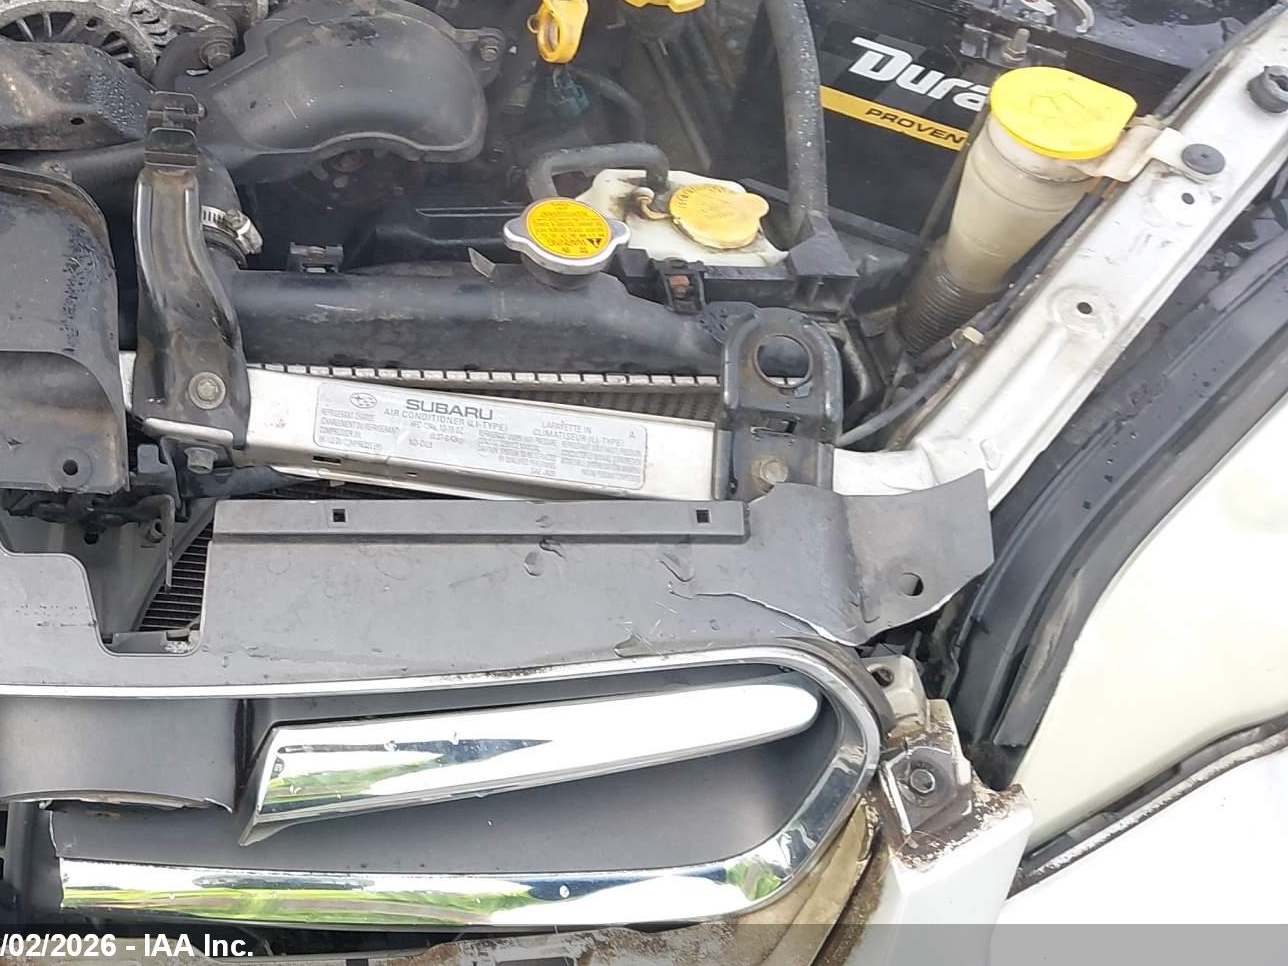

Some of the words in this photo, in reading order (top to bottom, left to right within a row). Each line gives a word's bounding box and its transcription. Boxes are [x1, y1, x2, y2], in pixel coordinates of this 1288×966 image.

[865, 107, 966, 144] PROVEN
[383, 408, 401, 418] AIR
[401, 409, 466, 426] CONDITIONER
[405, 398, 494, 421] SUBARU
